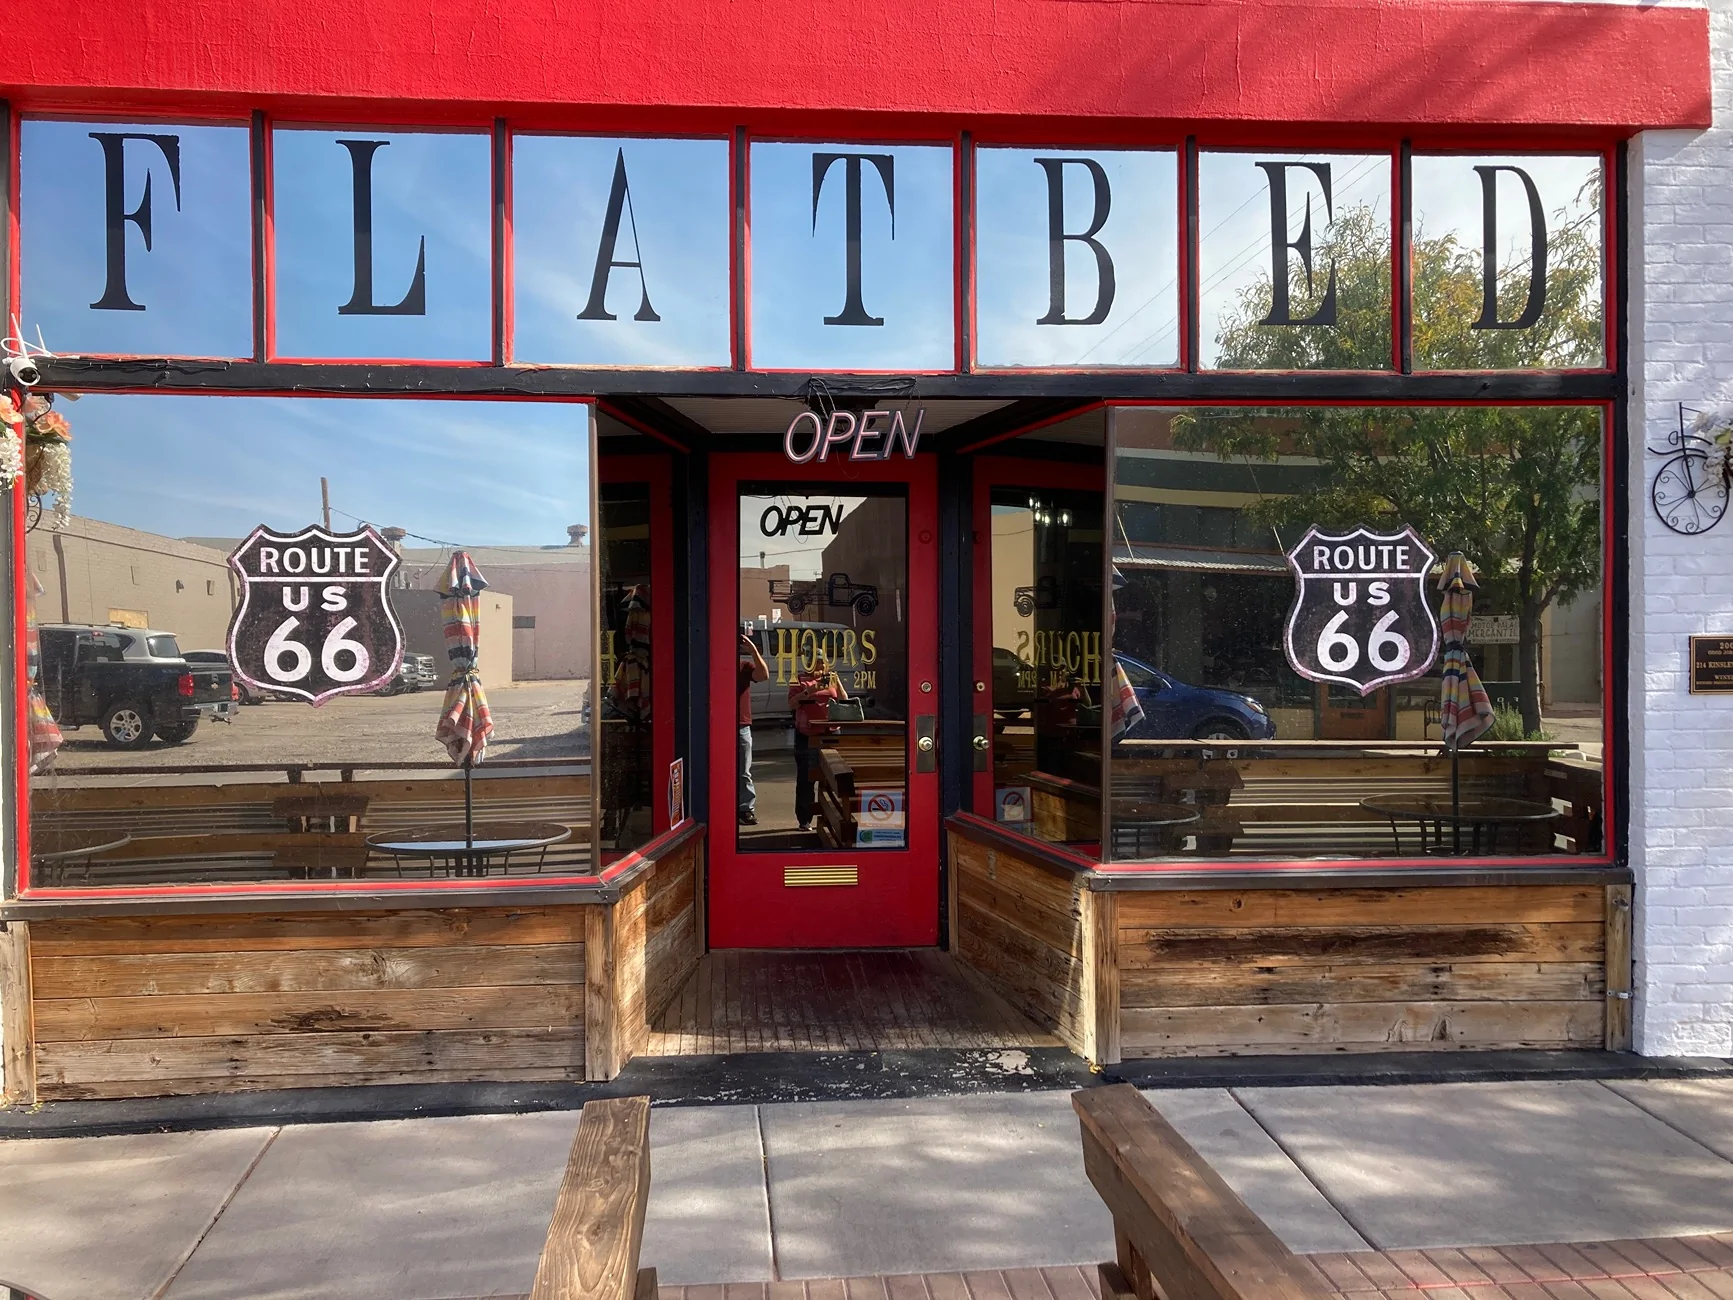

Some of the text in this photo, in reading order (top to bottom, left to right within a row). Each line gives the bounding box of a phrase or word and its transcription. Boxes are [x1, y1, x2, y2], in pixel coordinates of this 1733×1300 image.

[783, 408, 926, 464] OPEN
[760, 504, 844, 538] OPEN
[260, 547, 370, 574] ROUTE
[1313, 545, 1410, 571] ROUTE
[264, 615, 370, 682] 66
[775, 628, 877, 687] HOURS
[1317, 609, 1410, 672] 66
[853, 671, 877, 690] 2PM
[1696, 661, 1706, 669] 214
